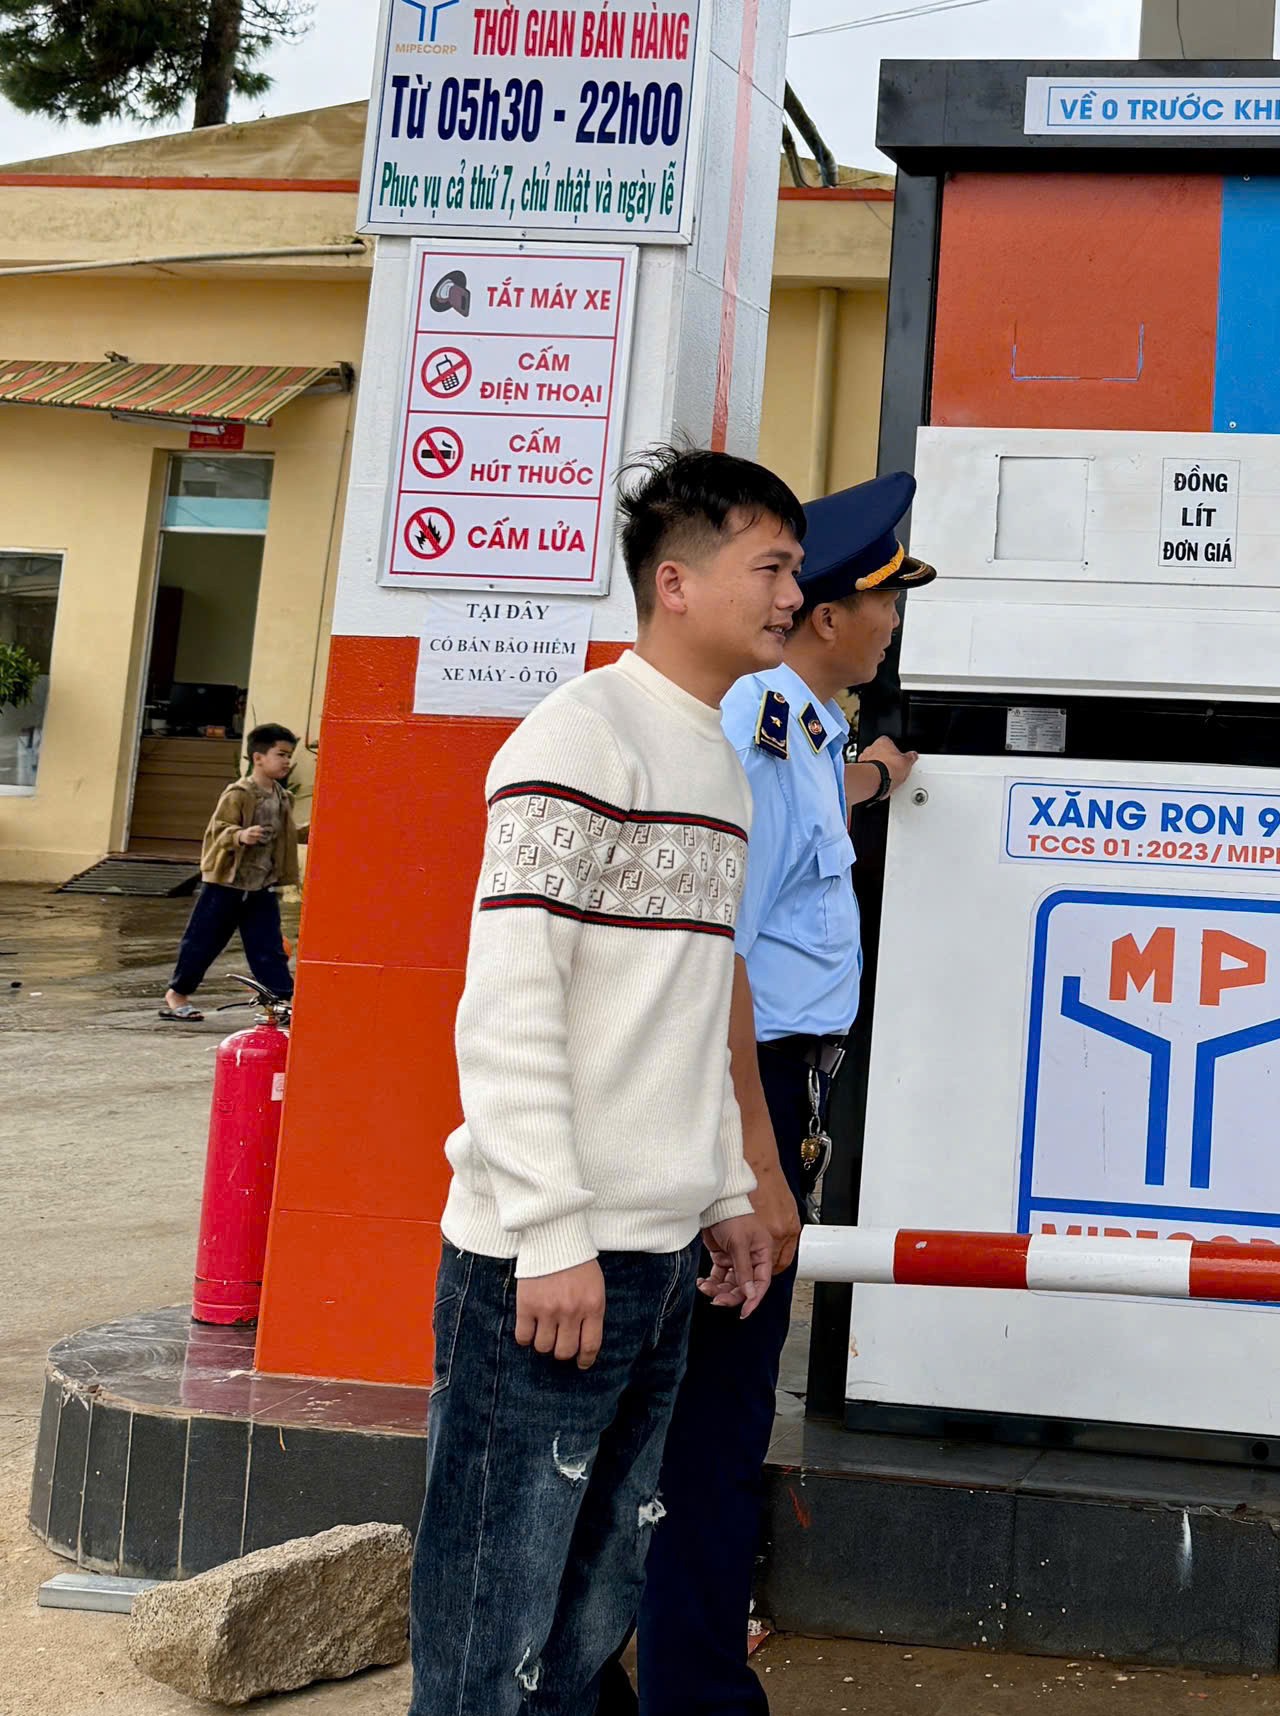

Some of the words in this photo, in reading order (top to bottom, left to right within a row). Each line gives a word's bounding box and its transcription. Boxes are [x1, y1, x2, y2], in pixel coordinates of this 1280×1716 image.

[473, 0, 519, 56] THỜI
[524, 9, 576, 58] GIAN
[580, 1, 626, 59] BÁN
[630, 3, 690, 60] HÀNG
[394, 43, 457, 55] MIPECORP
[391, 74, 432, 139] Từ
[437, 77, 544, 142] 05h30
[553, 109, 566, 122] -
[575, 80, 684, 146] 22h00
[1060, 90, 1098, 120] VỀ
[1102, 99, 1118, 120] 0
[1127, 93, 1224, 121] TRƯỚC
[1234, 99, 1280, 121] KHI
[379, 162, 418, 218] Phục
[424, 173, 441, 218] vụ
[446, 159, 466, 210] cả
[470, 163, 499, 210] thứ
[500, 165, 515, 220] 7,
[521, 161, 550, 212] chủ
[553, 167, 591, 223] nhật
[595, 167, 612, 213] và
[617, 169, 656, 223] ngày
[659, 160, 677, 215] lễ
[487, 277, 524, 309] TẮT
[531, 282, 578, 311] MÁY
[584, 290, 610, 311] XE
[518, 345, 570, 372] CẤM
[479, 377, 530, 405] ĐIỆN
[536, 383, 602, 408] THOẠI
[509, 427, 561, 454] CẤM
[470, 457, 511, 483] HÚT
[518, 459, 594, 486] THUỐC
[1174, 465, 1228, 494] ĐỒNG
[1181, 504, 1216, 528] LÍT
[467, 517, 529, 551] CẤM
[538, 520, 586, 552] LỬA
[1163, 540, 1200, 563] ĐƠN
[1203, 538, 1232, 563] GIÁ
[467, 603, 500, 622] TẠI
[430, 636, 453, 651] CÓ
[457, 636, 490, 652] BÁN
[441, 668, 464, 681] XE
[468, 665, 506, 682] MÁY
[519, 666, 531, 682] Ô
[535, 667, 557, 683] TÔ
[1029, 790, 1147, 831] XĂNG
[1161, 803, 1243, 837] RON
[1027, 834, 1095, 856] TCCS
